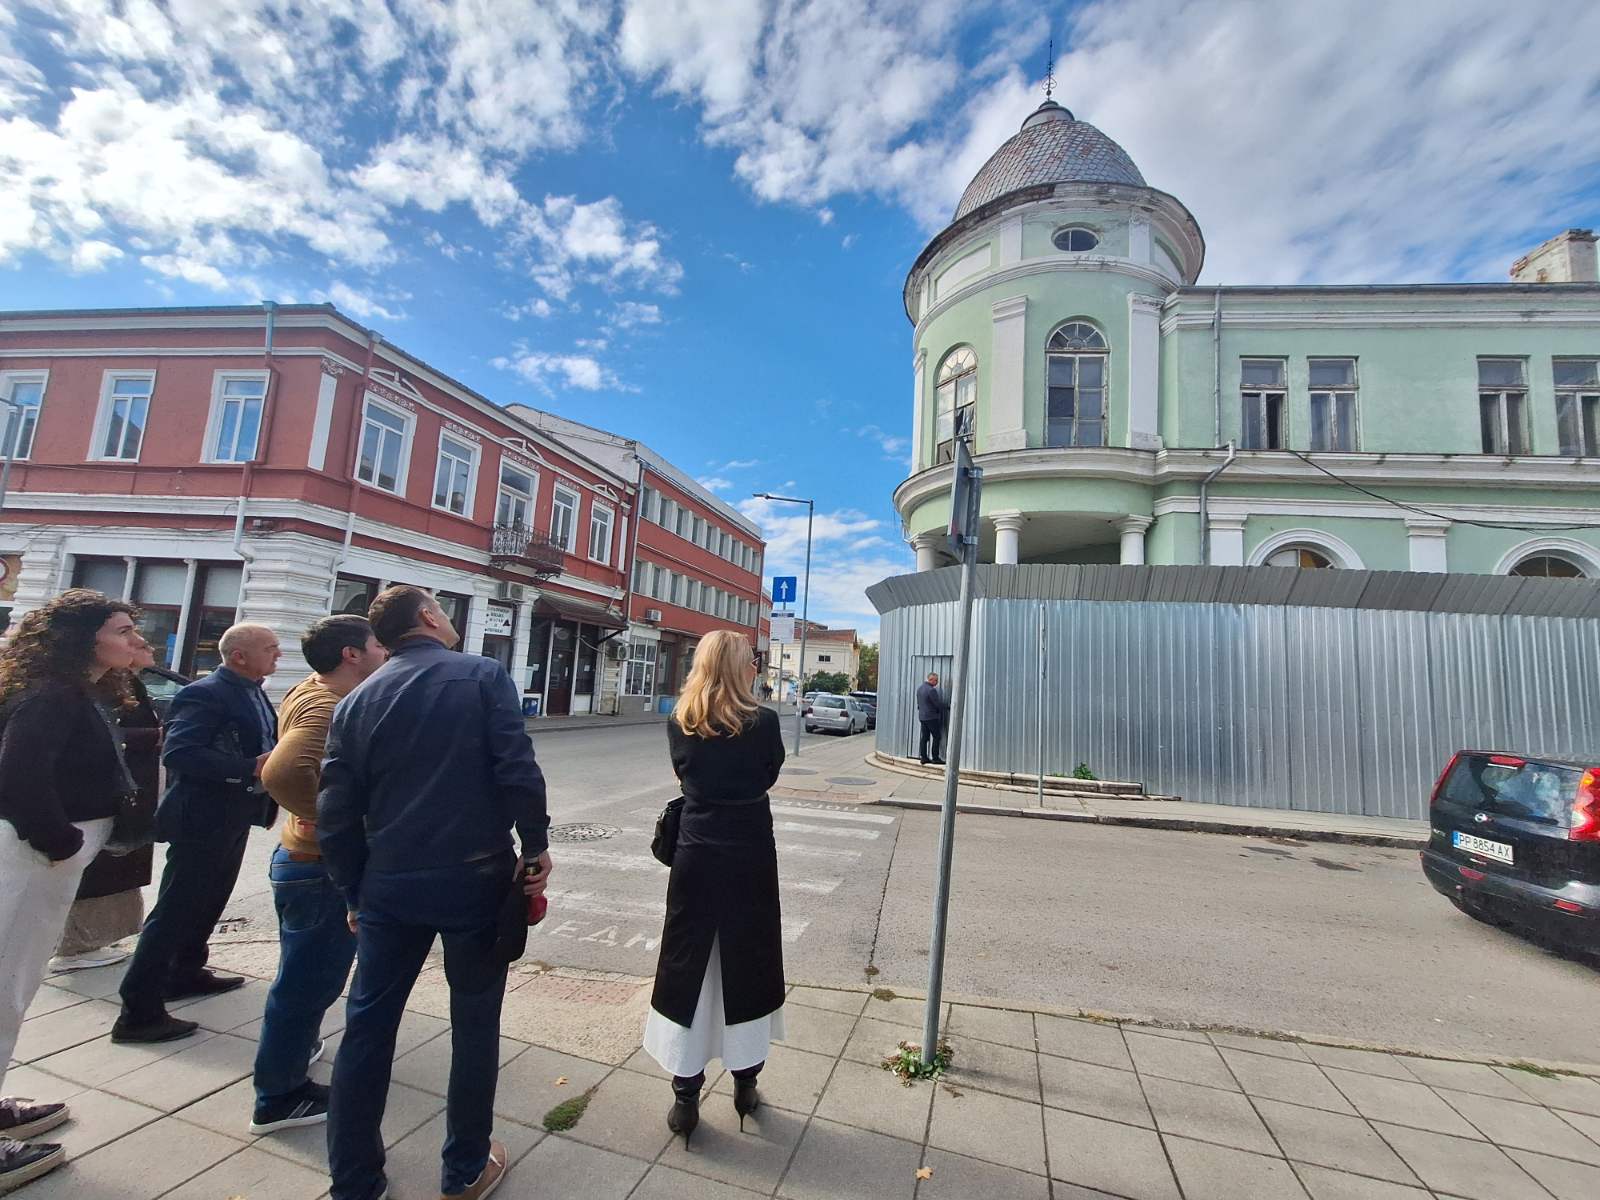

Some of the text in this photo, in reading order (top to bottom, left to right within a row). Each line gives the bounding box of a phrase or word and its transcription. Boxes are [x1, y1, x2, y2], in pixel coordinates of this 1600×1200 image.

[1459, 834, 1510, 859] PP 8854 AX
